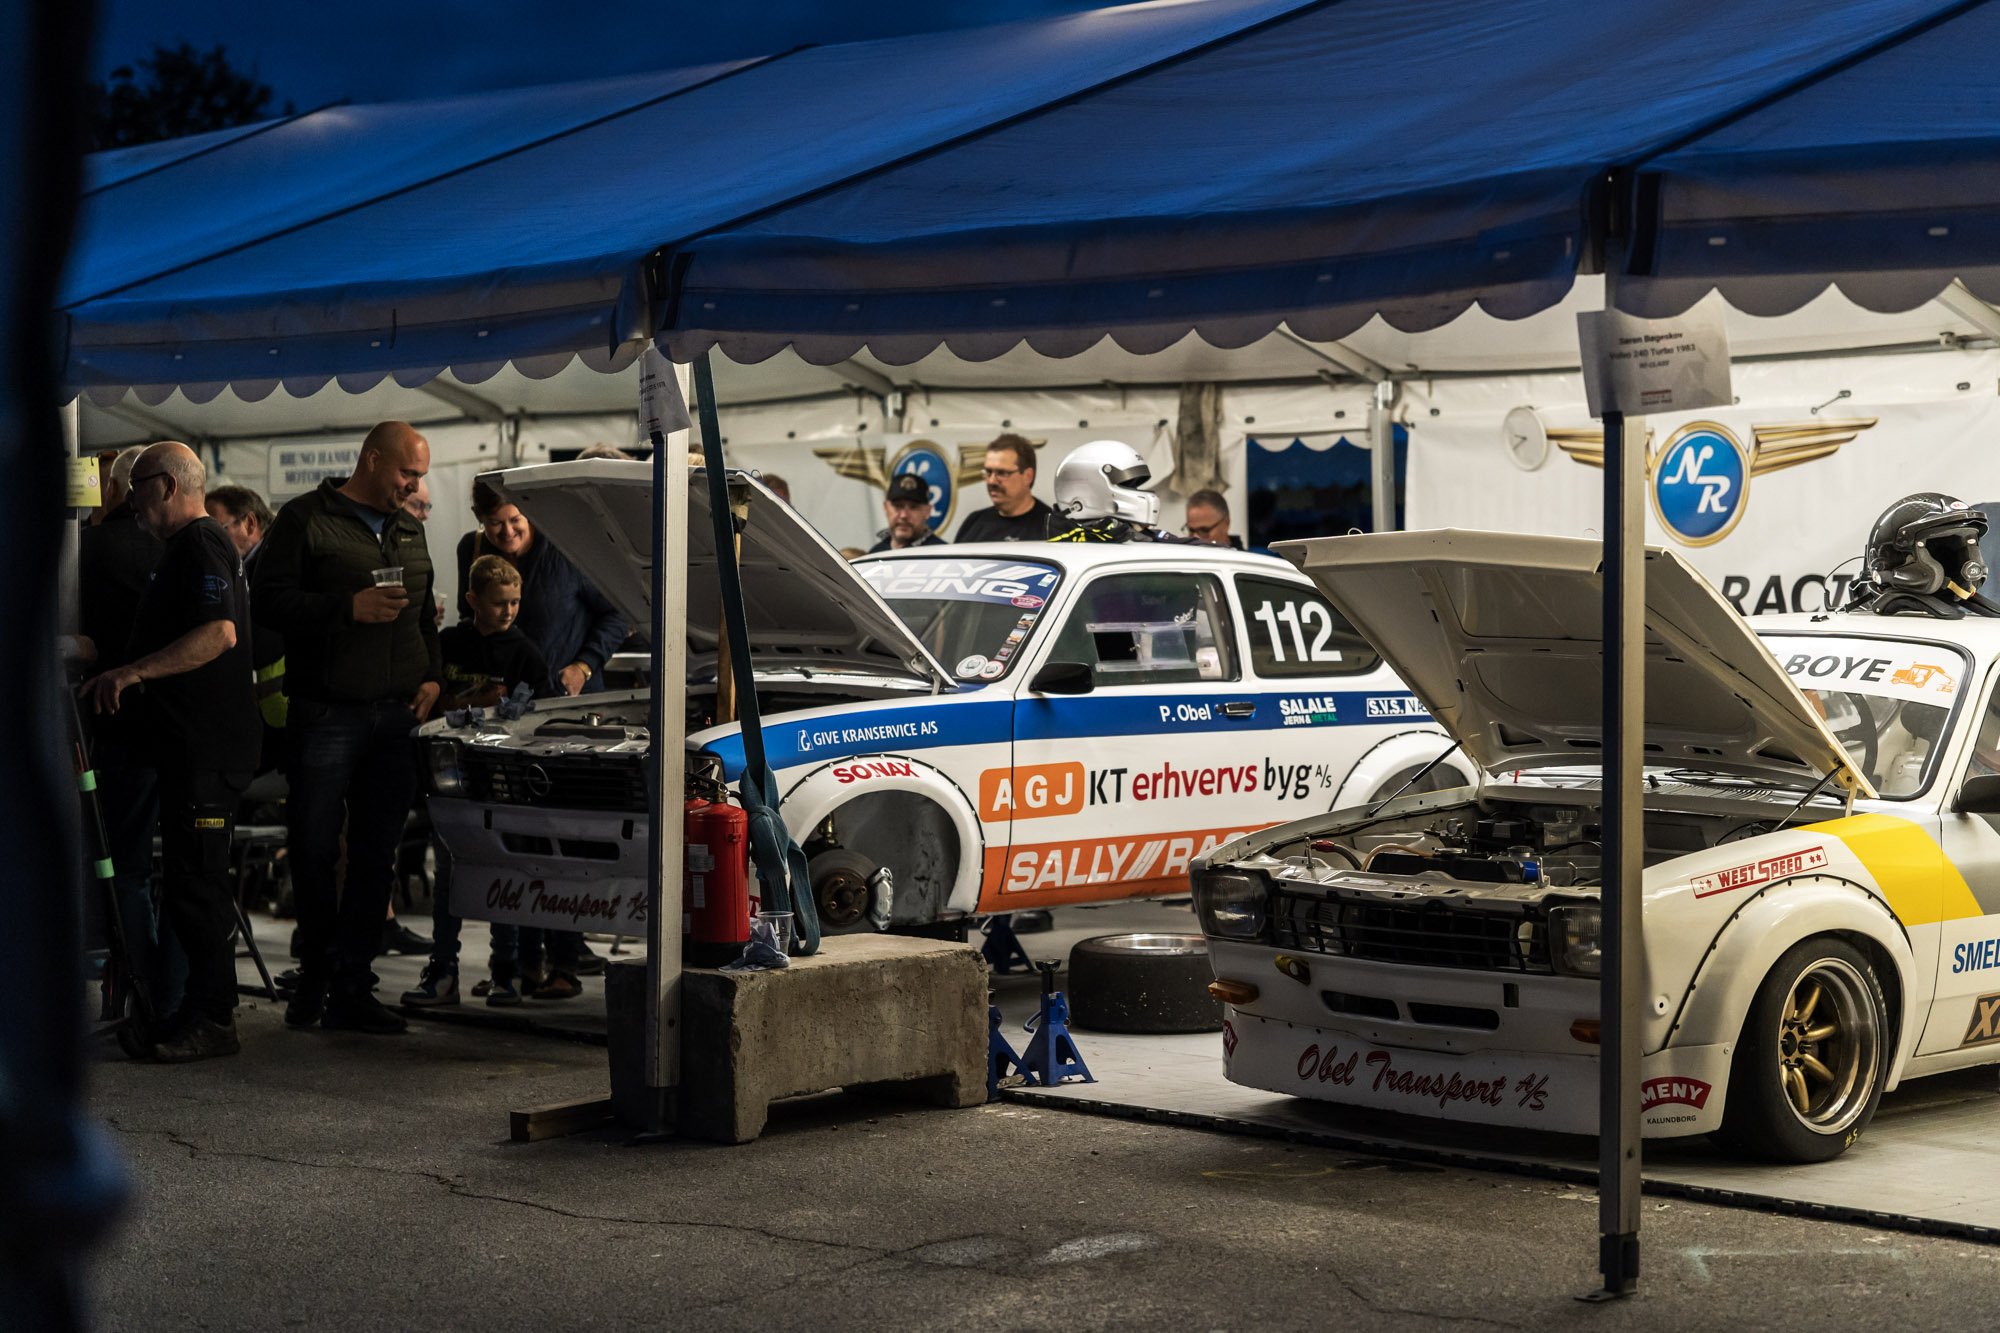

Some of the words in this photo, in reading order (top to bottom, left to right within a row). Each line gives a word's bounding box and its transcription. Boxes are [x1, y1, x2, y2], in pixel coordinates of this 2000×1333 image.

[860, 562, 999, 578] ALLY
[867, 578, 1029, 597] ACING
[1254, 600, 1343, 662] 112
[1784, 654, 1892, 682] BOYE
[1177, 703, 1211, 722] Obel
[1279, 697, 1337, 715] SALALE
[1369, 699, 1404, 715] S.V.S.
[813, 730, 840, 746] GIVE
[842, 722, 918, 743] KRANSERVICE
[920, 720, 938, 735] A/S
[832, 762, 920, 784] SONAX
[1089, 767, 1127, 806] KT
[1315, 763, 1332, 788] A/S
[1007, 841, 1136, 892] SALLY
[1718, 864, 1755, 888] WEST
[486, 878, 524, 911] Obel
[528, 879, 622, 924] Transport
[1297, 1043, 1358, 1087] Obel
[1366, 1050, 1507, 1109] Transport
[1515, 1072, 1549, 1111] A/S
[1641, 1082, 1703, 1105] MENY
[1647, 1114, 1697, 1125] KALUNDBORG
